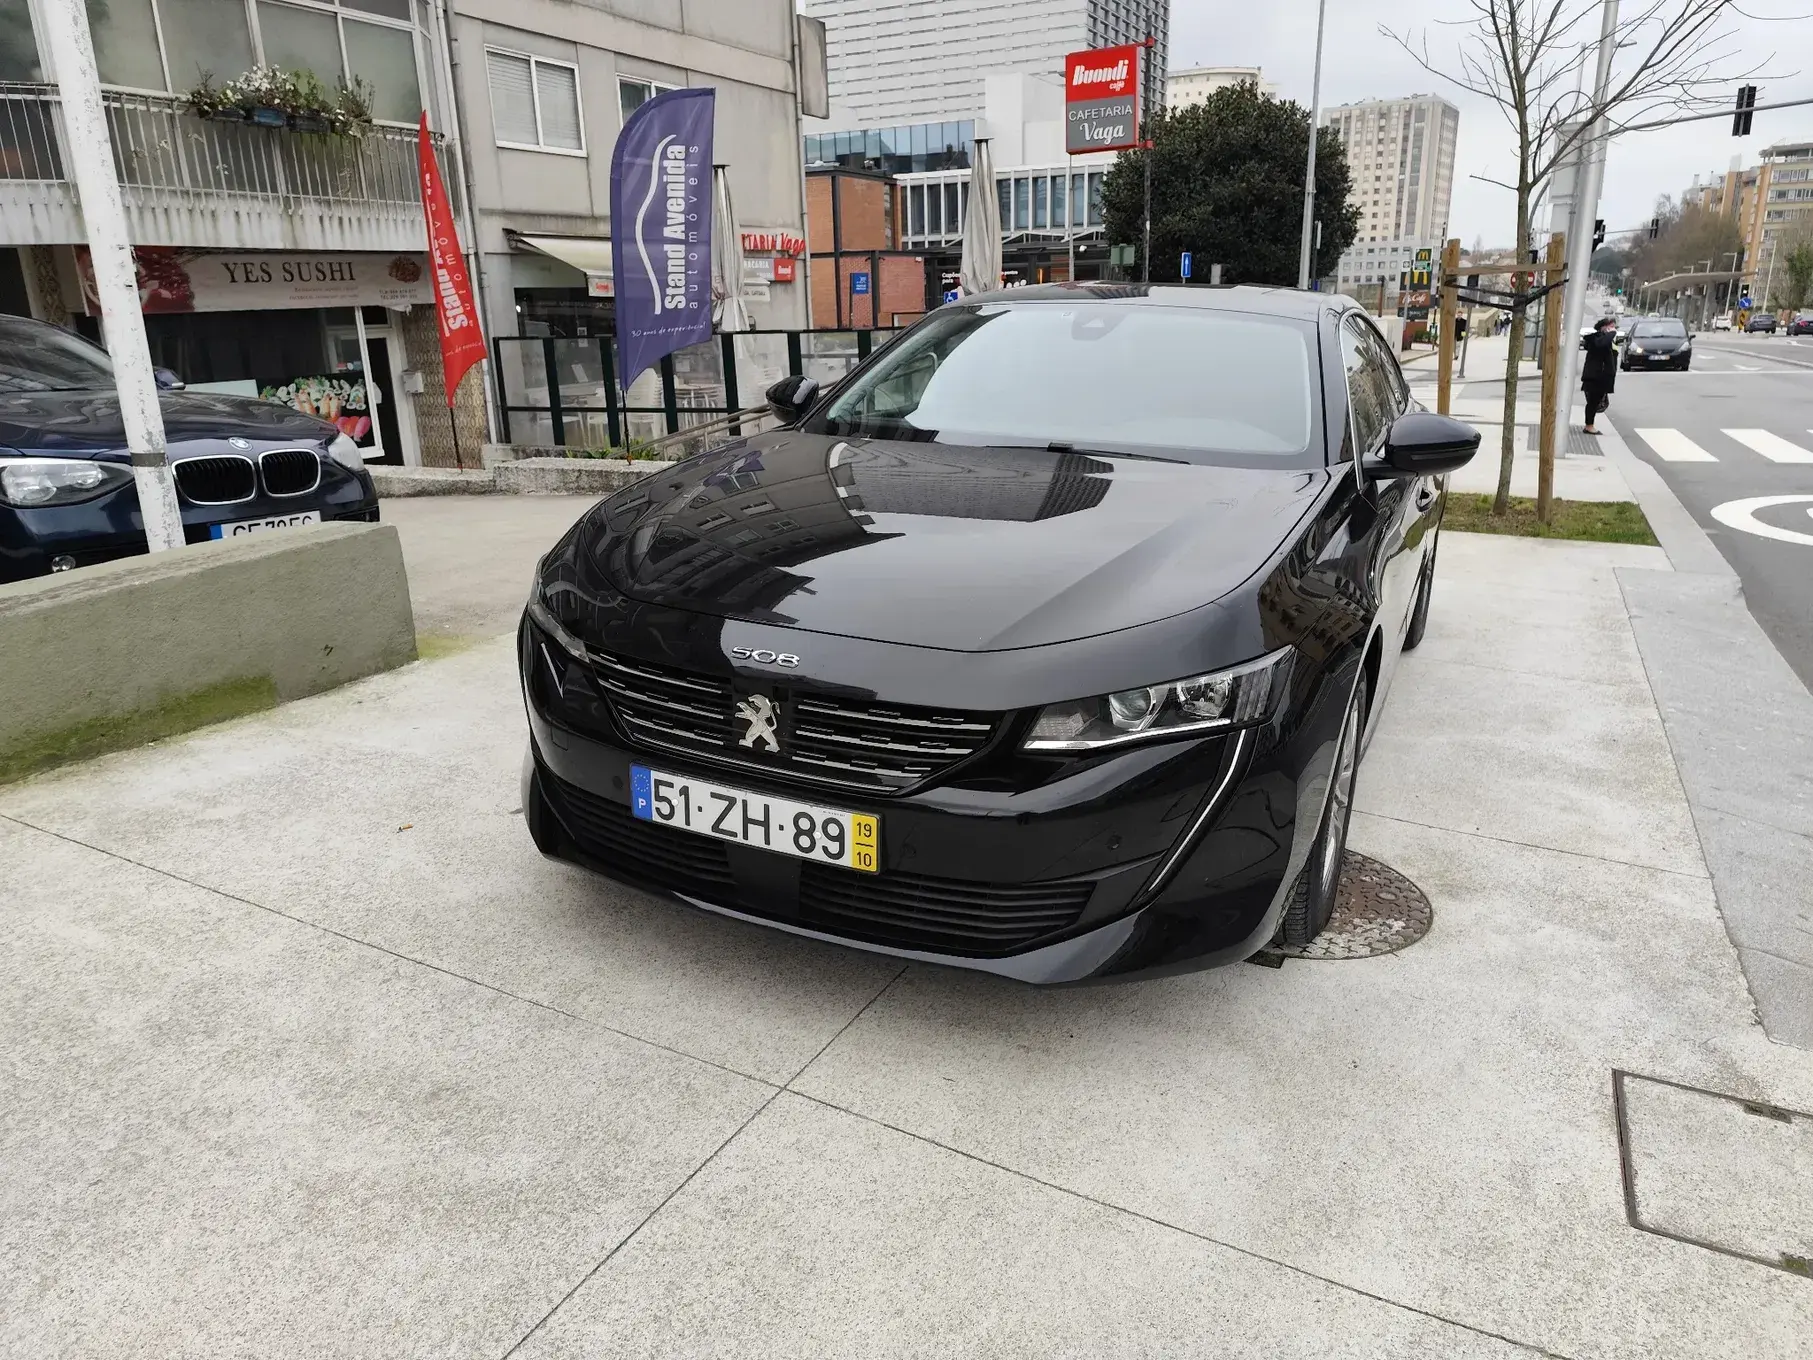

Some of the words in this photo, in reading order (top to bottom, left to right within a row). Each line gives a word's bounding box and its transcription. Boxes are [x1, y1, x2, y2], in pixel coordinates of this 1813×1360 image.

[1072, 59, 1129, 86] Buondi
[1068, 104, 1133, 121] CAFETARIA
[1080, 121, 1126, 145] Vaga
[663, 145, 686, 240] Avenida
[687, 146, 699, 309] automóveis
[221, 261, 272, 284] YES
[282, 260, 356, 283] SUSHI
[663, 244, 686, 310] Stand
[730, 646, 800, 668] 508
[638, 797, 647, 808] P
[856, 821, 872, 838] 19
[856, 851, 872, 868] 10
